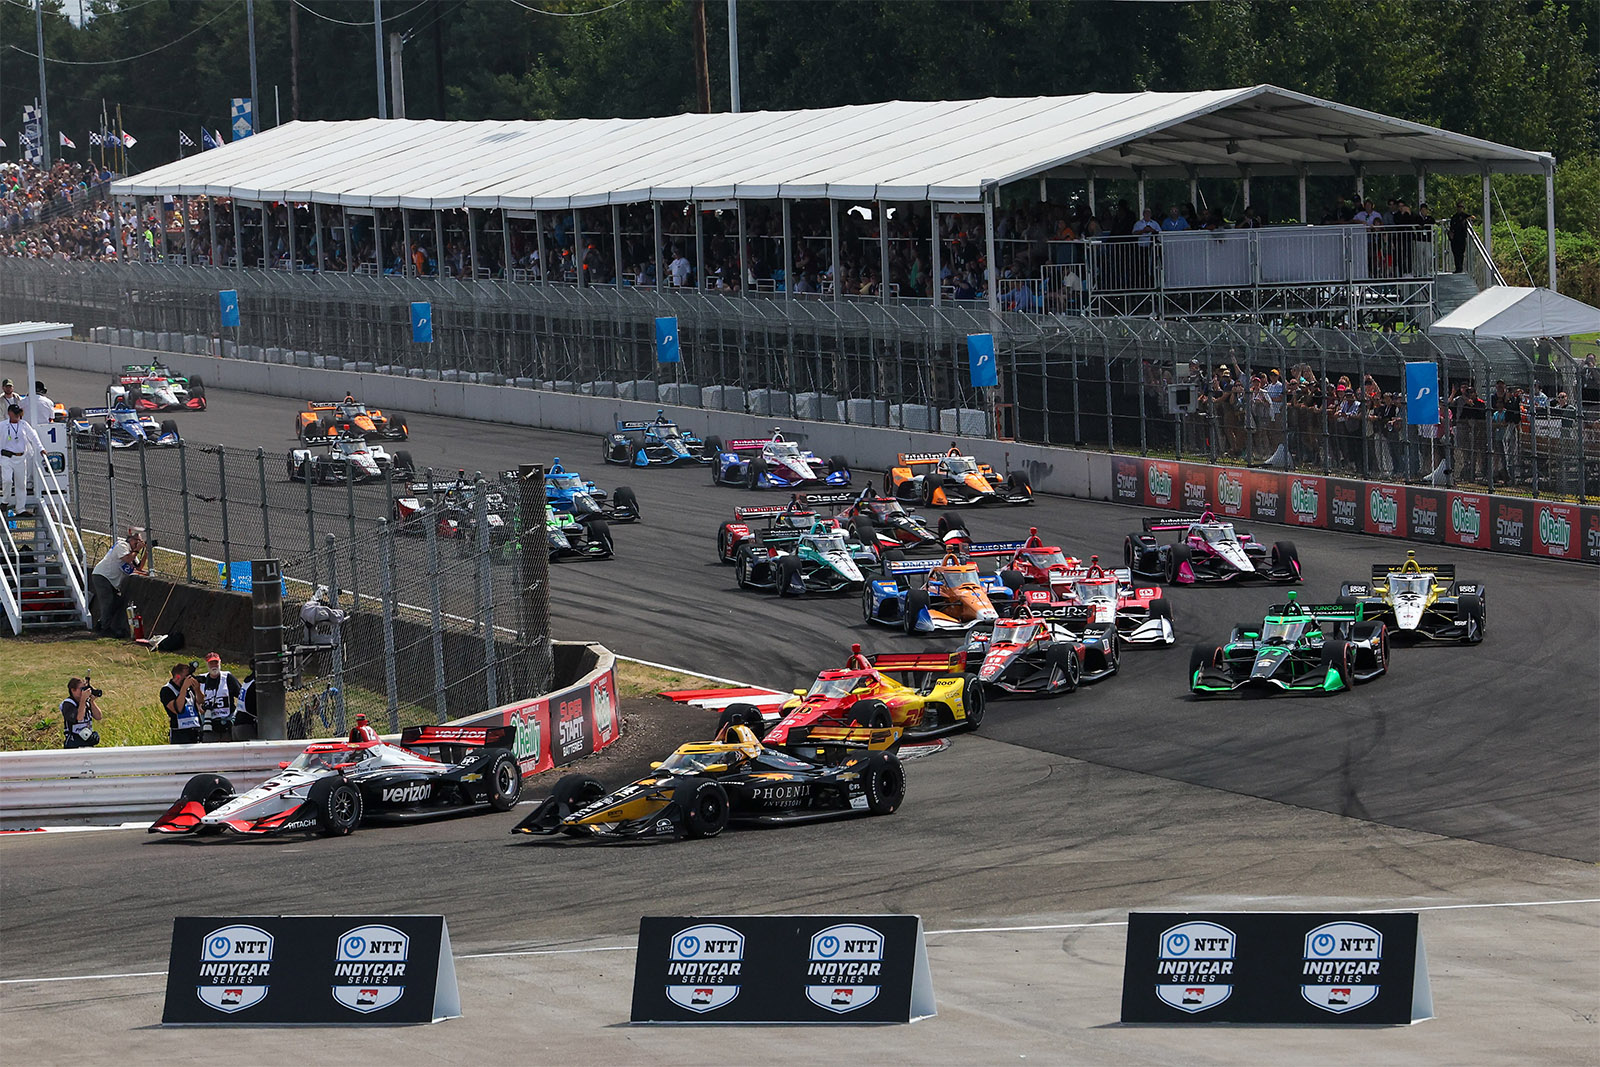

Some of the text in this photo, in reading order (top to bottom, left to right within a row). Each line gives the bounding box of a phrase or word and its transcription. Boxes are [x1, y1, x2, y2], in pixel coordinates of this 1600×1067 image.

[48, 428, 56, 443] 1
[1116, 473, 1137, 490] START
[1184, 482, 1206, 498] START
[1256, 490, 1279, 508] START
[1332, 498, 1356, 516] START
[1370, 488, 1398, 528] O'Reilly
[1334, 516, 1354, 526] BATTERIES
[1412, 507, 1438, 526] START
[1452, 498, 1480, 538] O'Reilly
[1414, 526, 1436, 536] BATTERIES
[1496, 518, 1524, 537] START
[1540, 508, 1571, 551] O'Reilly
[1500, 536, 1521, 547] BATTERIES
[1031, 606, 1088, 618] oodRx
[560, 698, 583, 722] SUPER
[361, 726, 376, 740] 12
[435, 729, 486, 738] verizon
[510, 710, 541, 765] O'Reilly
[560, 716, 584, 746] START
[562, 740, 583, 757] BATTERIES
[382, 782, 432, 802] verizon
[753, 784, 812, 800] PHOENIX
[288, 819, 316, 830] HITACHI
[234, 941, 268, 954] NTT
[369, 941, 402, 954] NTT
[704, 940, 738, 953] NTT
[843, 940, 878, 953] NTT
[1194, 938, 1229, 951] NTT
[1340, 938, 1375, 951] NTT
[200, 964, 270, 976] INDYCAR
[334, 964, 406, 976] INDYCAR
[668, 962, 741, 976] INDYCAR
[808, 962, 881, 976] INDYCAR
[1158, 962, 1233, 974] INDYCAR
[1302, 962, 1380, 974] INDYCAR
[212, 976, 254, 984] SERIES
[348, 976, 389, 984] SERIES
[682, 976, 724, 984] SERIES
[821, 976, 864, 984] SERIES
[1172, 974, 1216, 982] SERIES
[1317, 974, 1362, 982] SERIES
